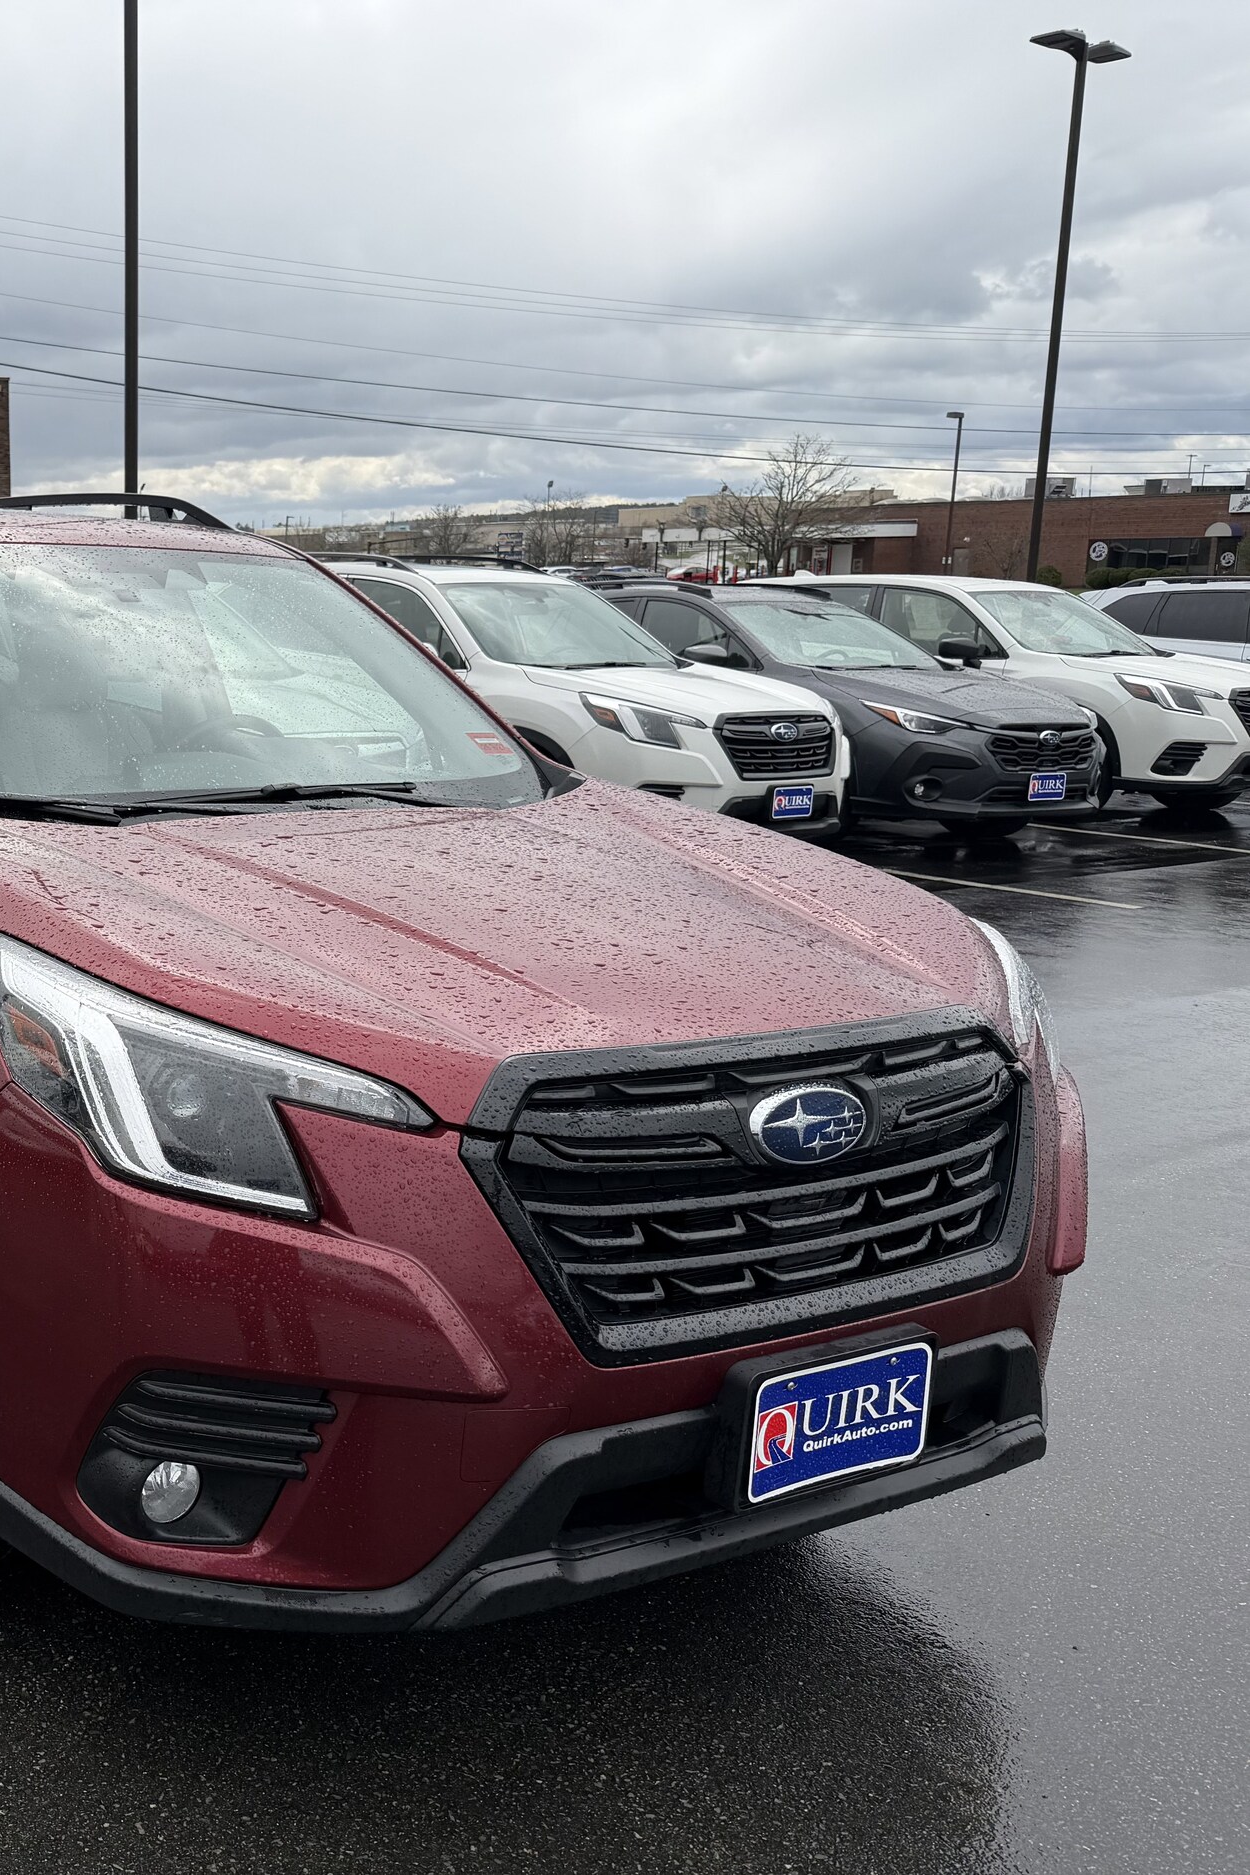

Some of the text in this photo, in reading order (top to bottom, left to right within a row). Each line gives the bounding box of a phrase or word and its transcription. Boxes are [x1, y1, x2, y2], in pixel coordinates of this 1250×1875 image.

[1031, 779, 1064, 794] QUIRK
[774, 795, 812, 811] QUIRK
[756, 1374, 922, 1466] QUIRK
[803, 1418, 913, 1453] QuirkAuto.com
